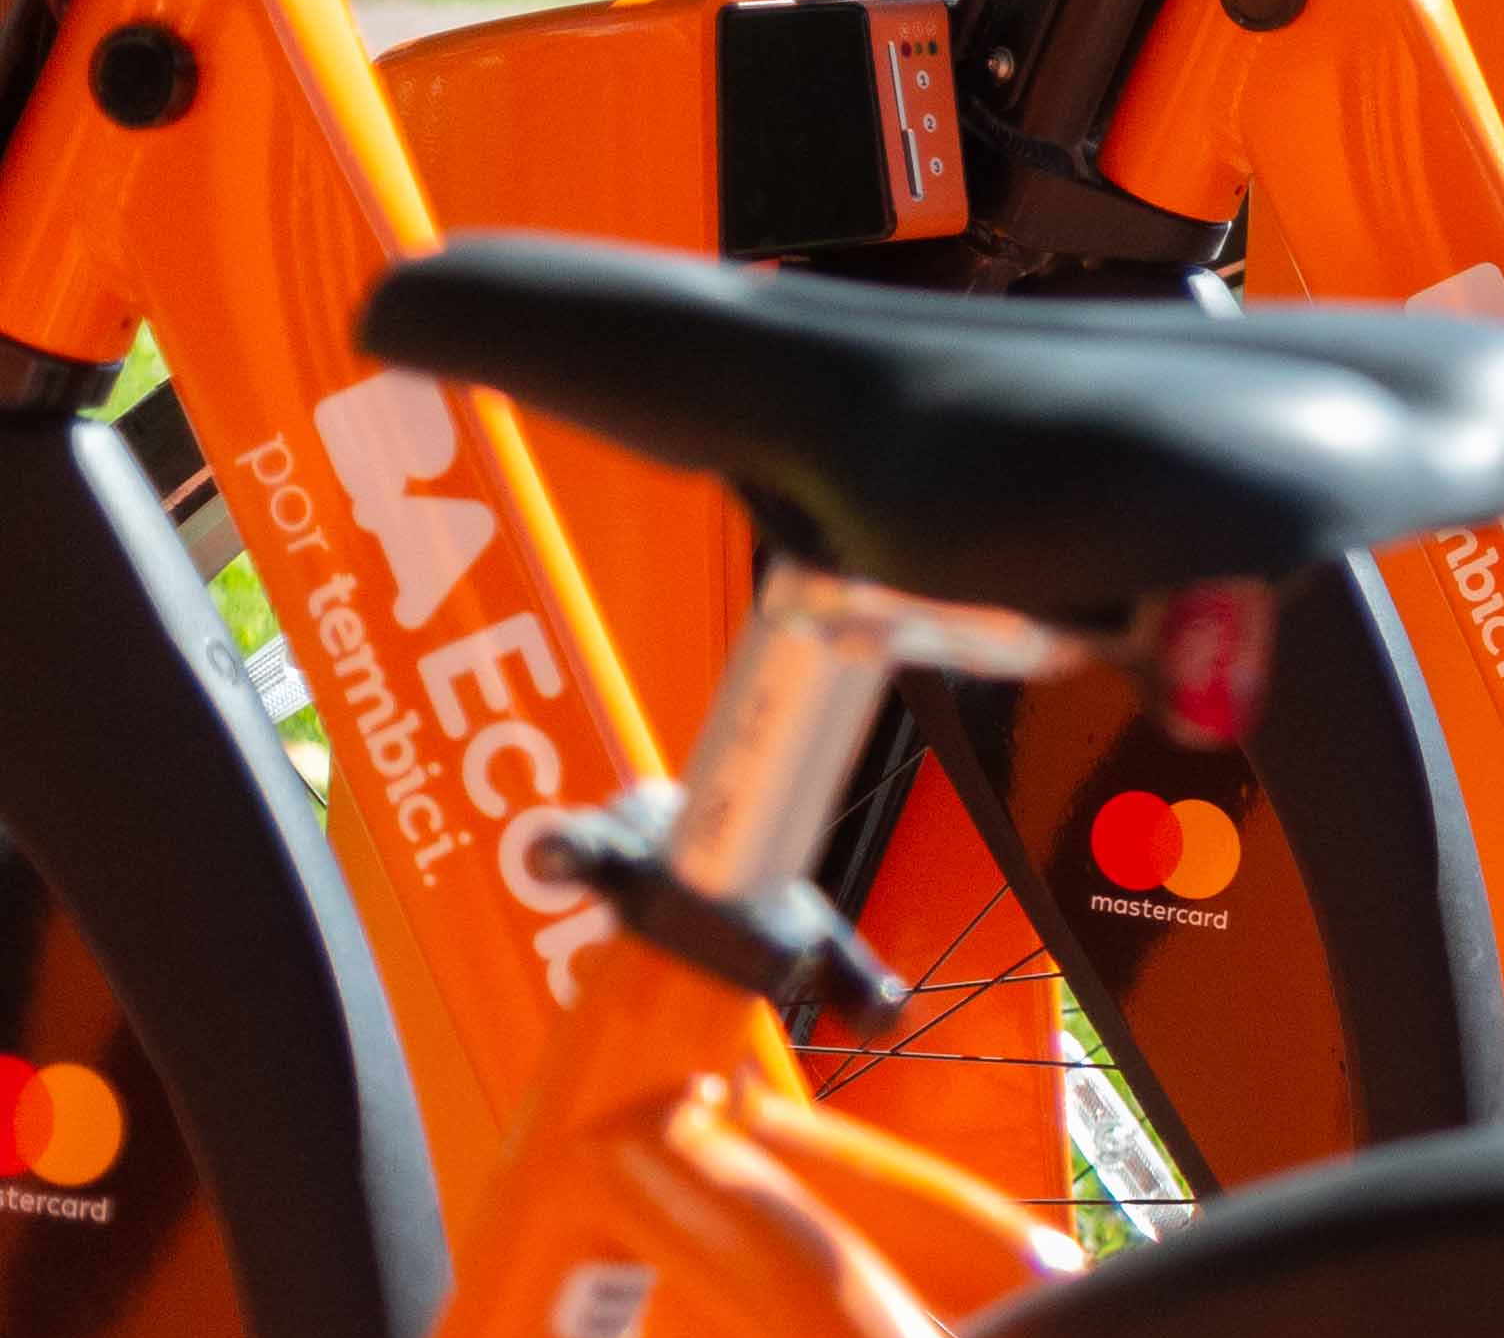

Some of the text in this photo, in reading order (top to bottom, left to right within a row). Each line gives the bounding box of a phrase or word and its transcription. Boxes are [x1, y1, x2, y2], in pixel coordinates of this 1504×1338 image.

[235, 431, 472, 888] por tembici.
[1090, 894, 1229, 931] mastercard
